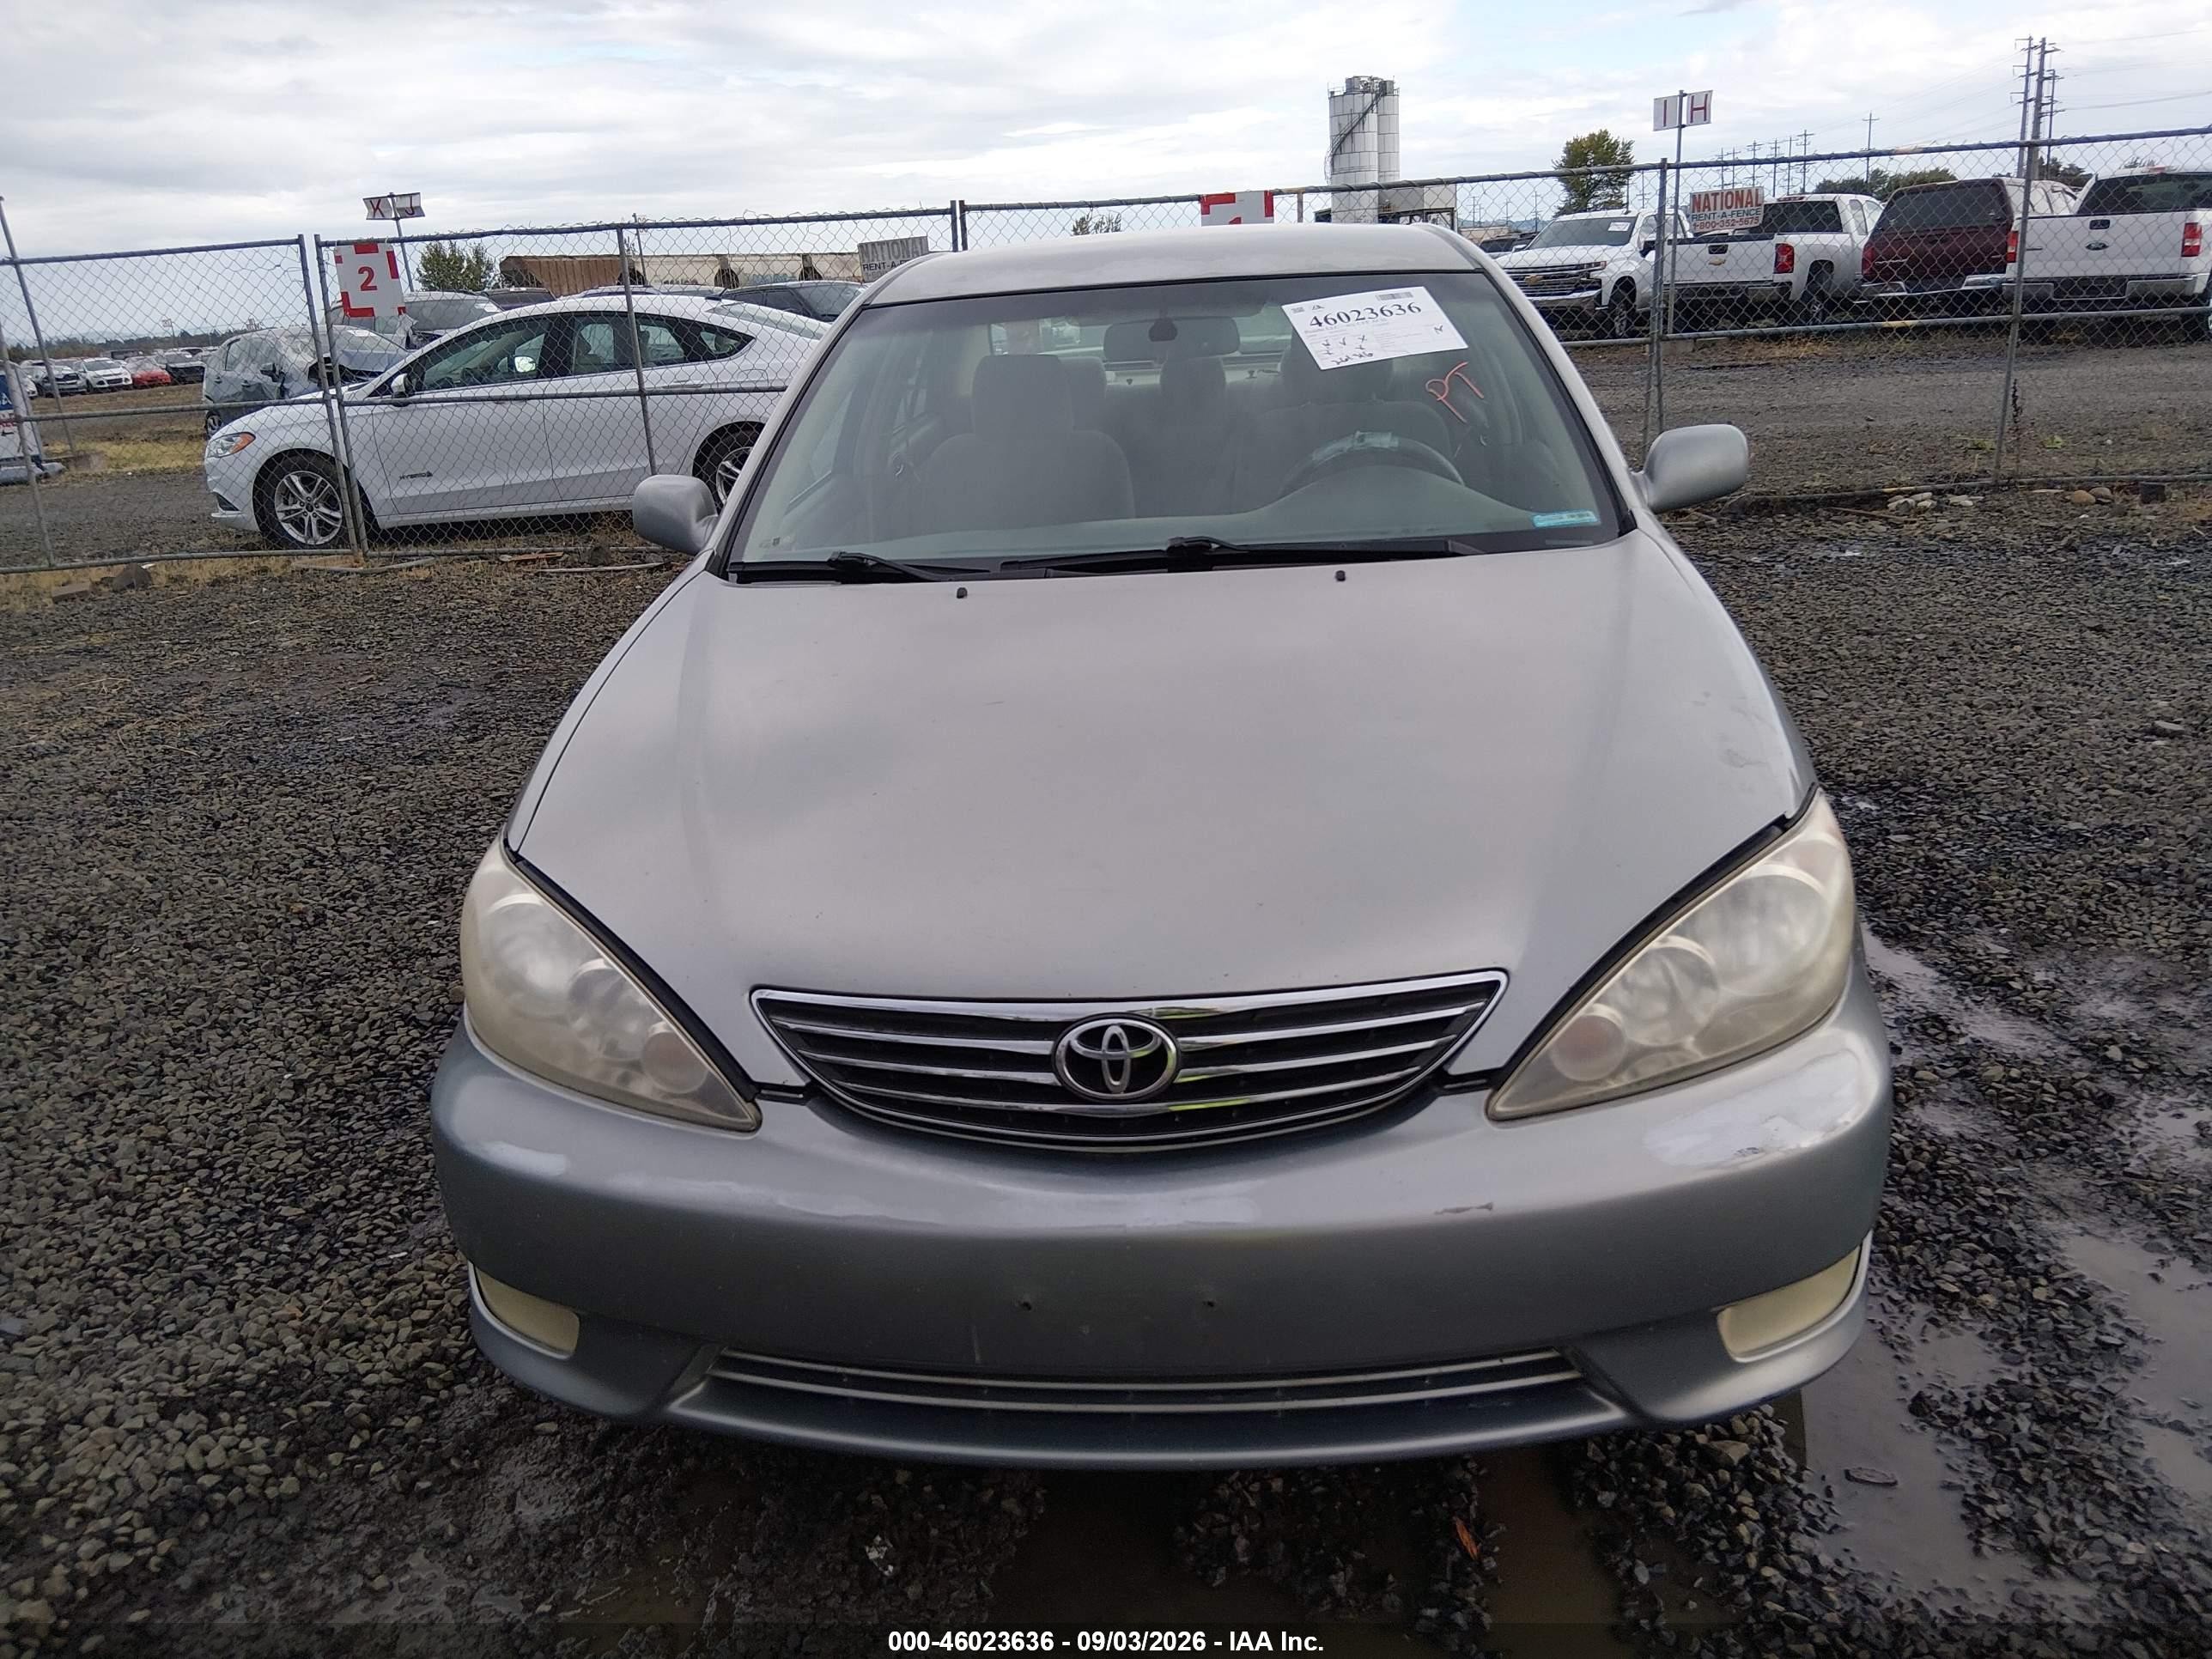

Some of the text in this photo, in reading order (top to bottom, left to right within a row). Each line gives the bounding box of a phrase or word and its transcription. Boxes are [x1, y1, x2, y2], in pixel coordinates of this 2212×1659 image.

[1689, 93, 1709, 124] H
[369, 198, 386, 217] K
[404, 195, 415, 216] J
[1692, 188, 1761, 213] NATIONAL
[1692, 207, 1760, 222] RENT-A-FENCE
[860, 238, 927, 263] NATIONAL
[357, 266, 378, 291] 2
[1310, 301, 1422, 327] 46023636
